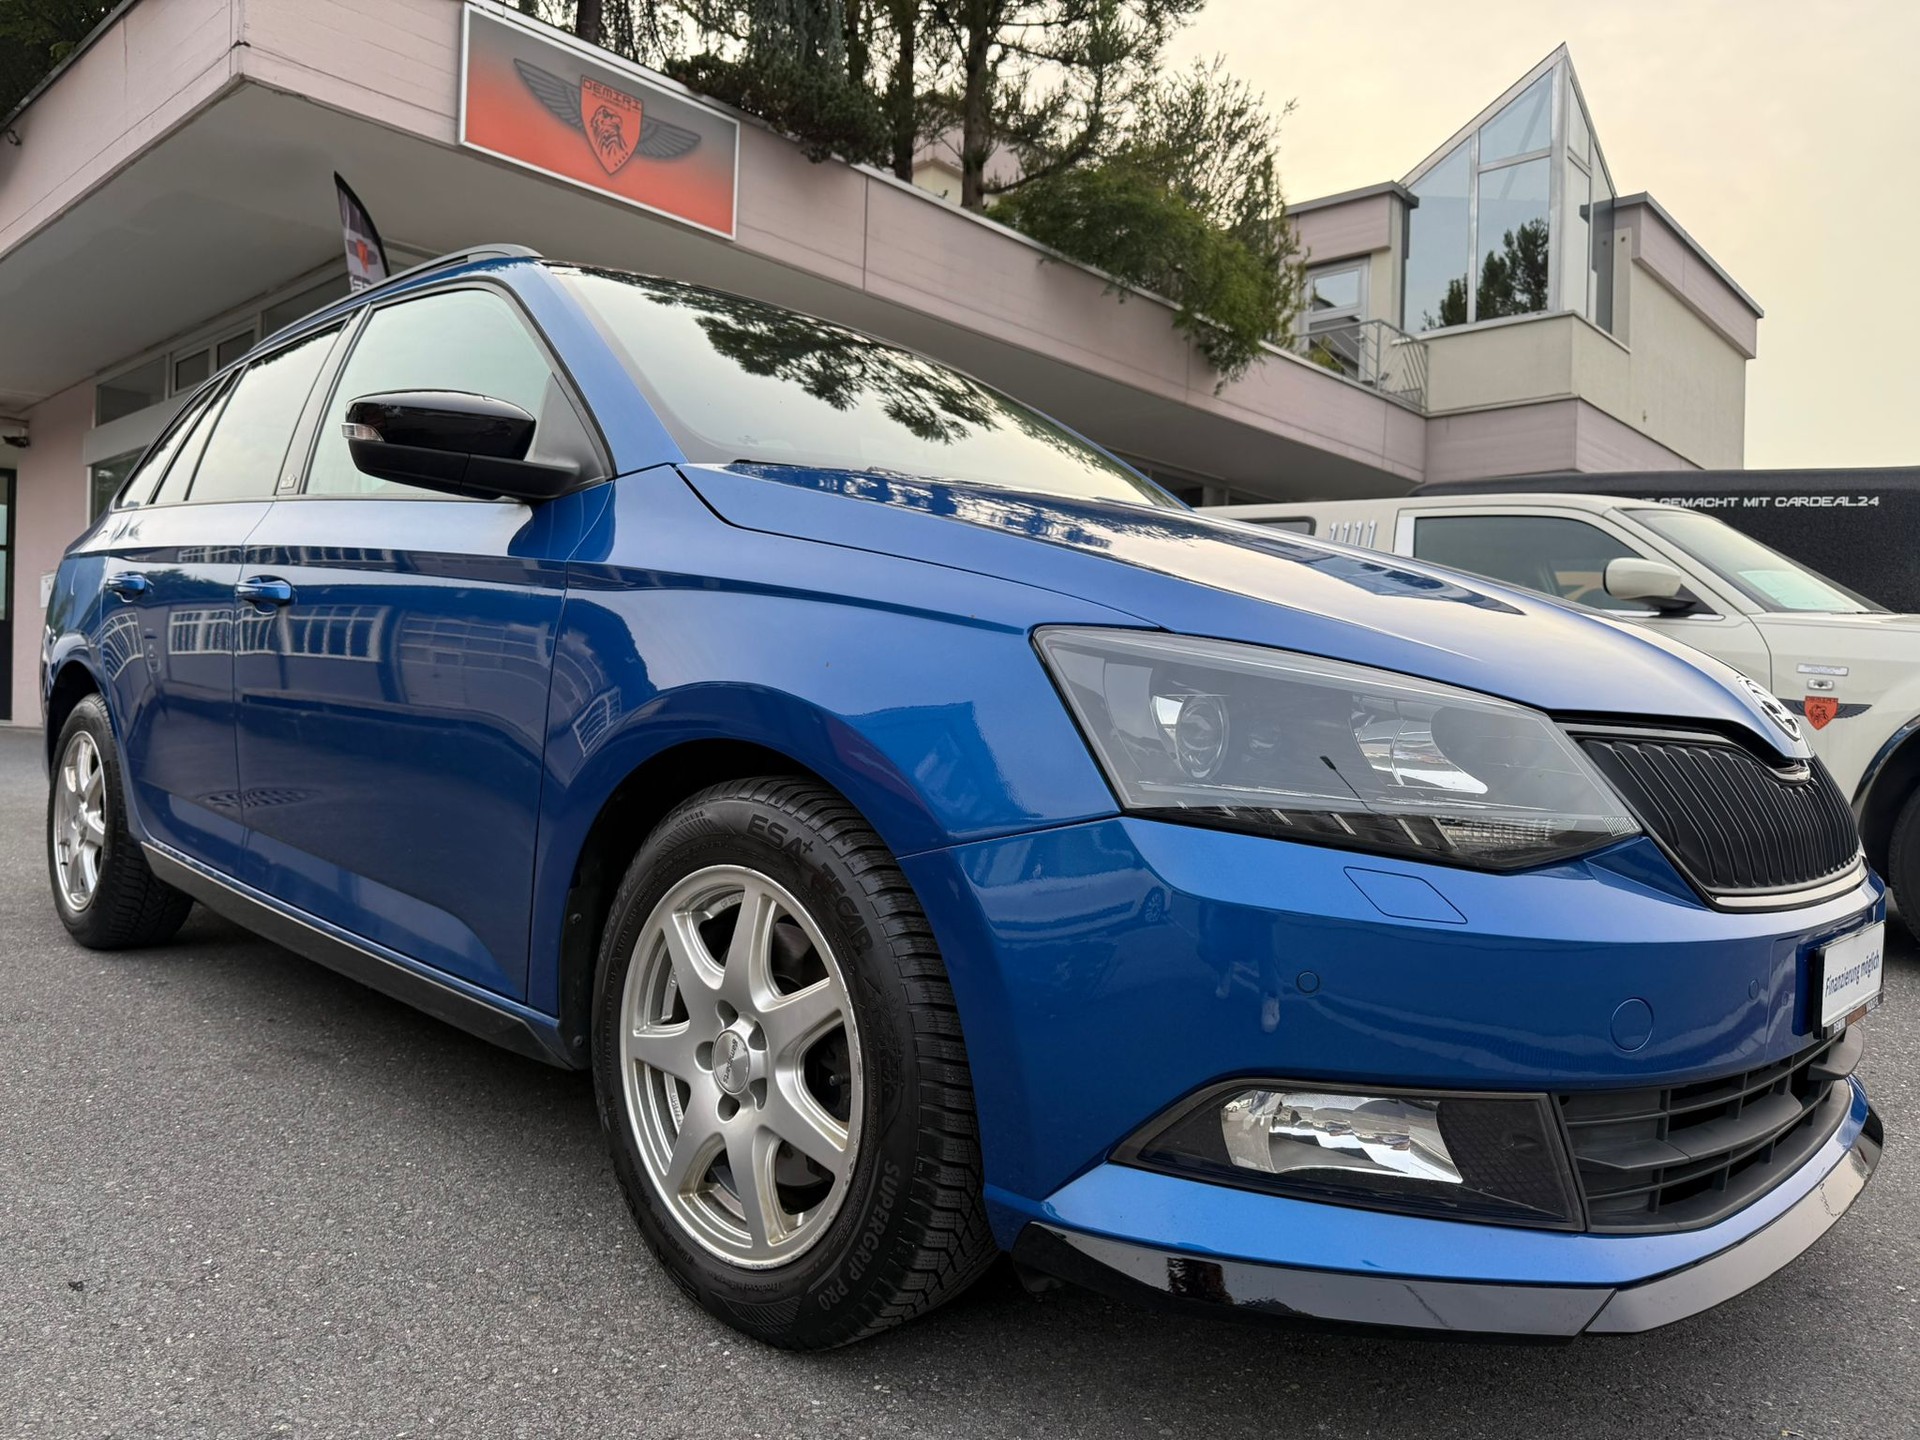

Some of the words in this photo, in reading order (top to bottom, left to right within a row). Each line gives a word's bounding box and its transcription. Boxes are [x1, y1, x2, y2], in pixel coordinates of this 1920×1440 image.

[583, 79, 641, 111] DEMIRI
[1742, 497, 1771, 508] MIT
[1774, 496, 1880, 508] CARDEAL24
[1825, 964, 1860, 998] Finanzierung
[1860, 949, 1880, 979] möglich
[817, 1276, 850, 1312] PRO
